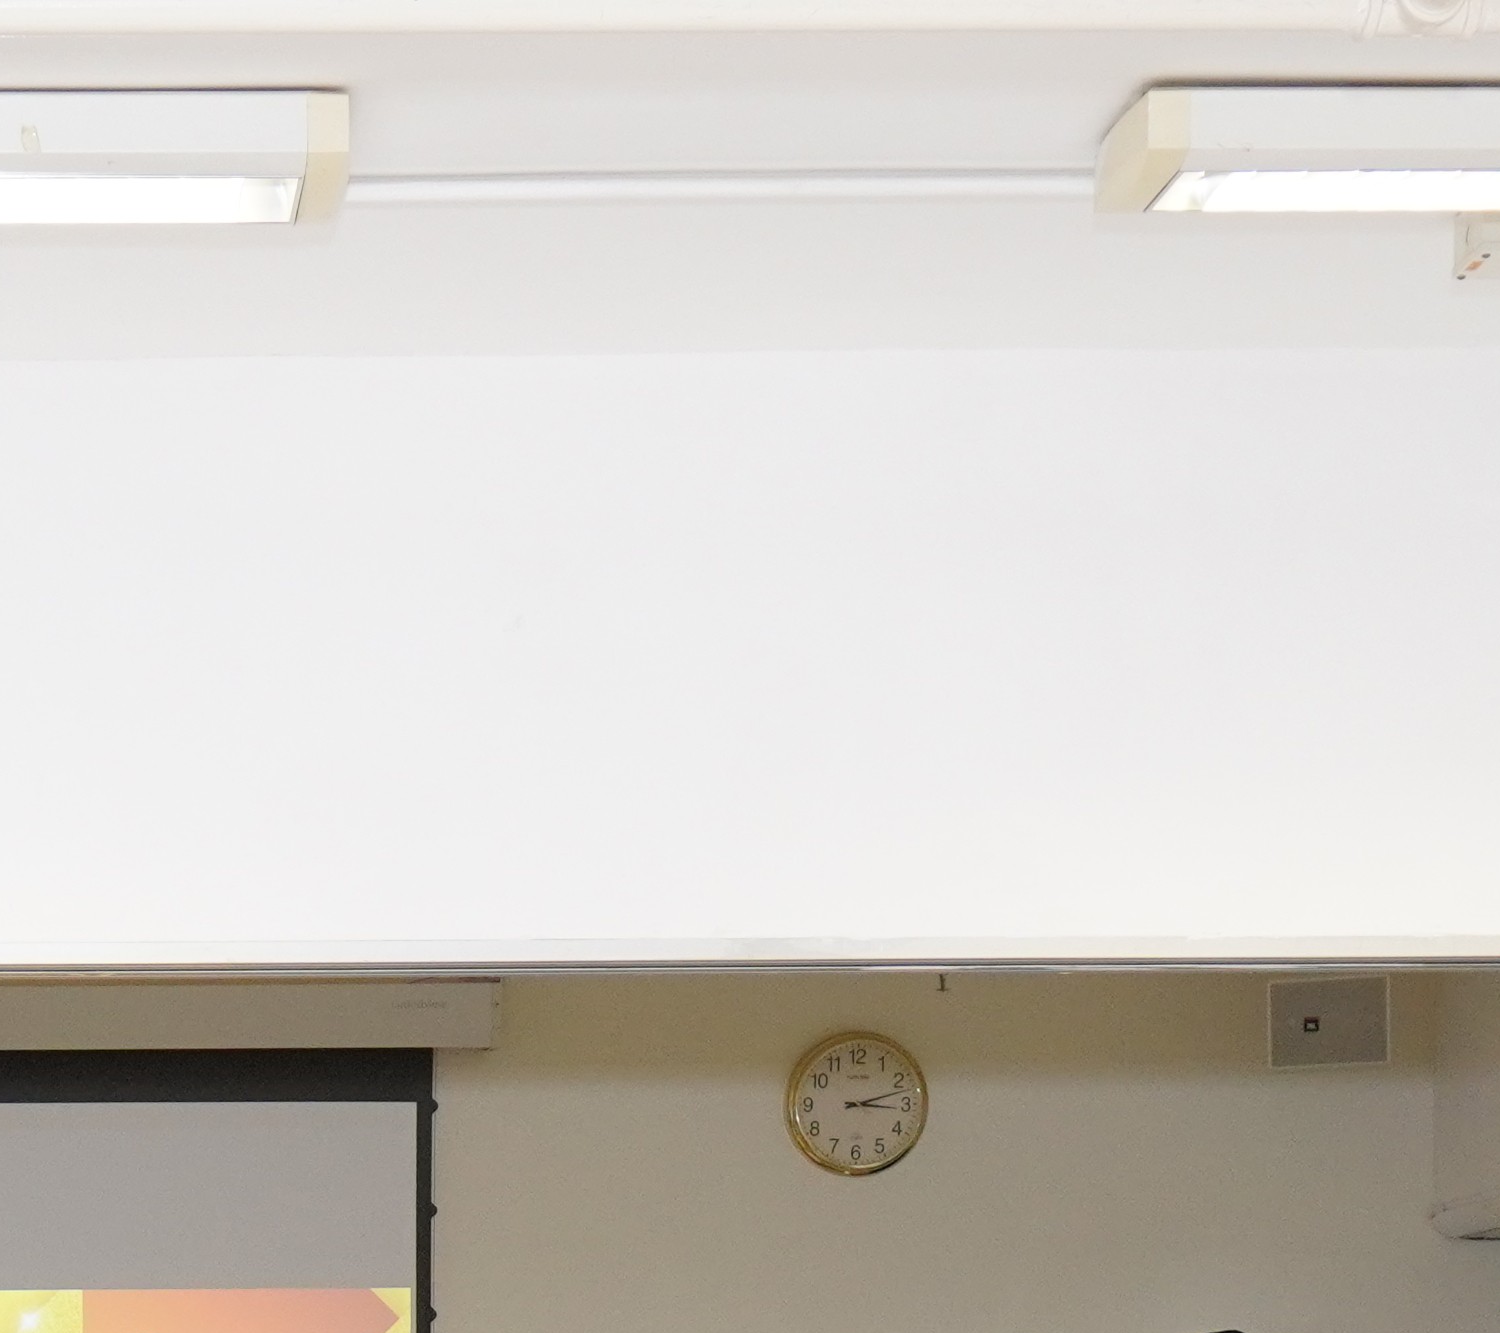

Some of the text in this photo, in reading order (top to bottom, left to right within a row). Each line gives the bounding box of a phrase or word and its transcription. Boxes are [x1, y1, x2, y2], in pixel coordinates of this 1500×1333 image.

[828, 1056, 841, 1071] 11
[849, 1049, 867, 1064] 12
[878, 1056, 885, 1071] 1
[811, 1073, 828, 1088] 10
[894, 1073, 904, 1088] 2
[803, 1097, 813, 1112] 9
[901, 1097, 911, 1112] 3
[809, 1121, 820, 1136] 8
[892, 1121, 903, 1136] 4
[829, 1139, 840, 1153] 7
[851, 1145, 861, 1160] 6
[874, 1138, 885, 1153] 5
